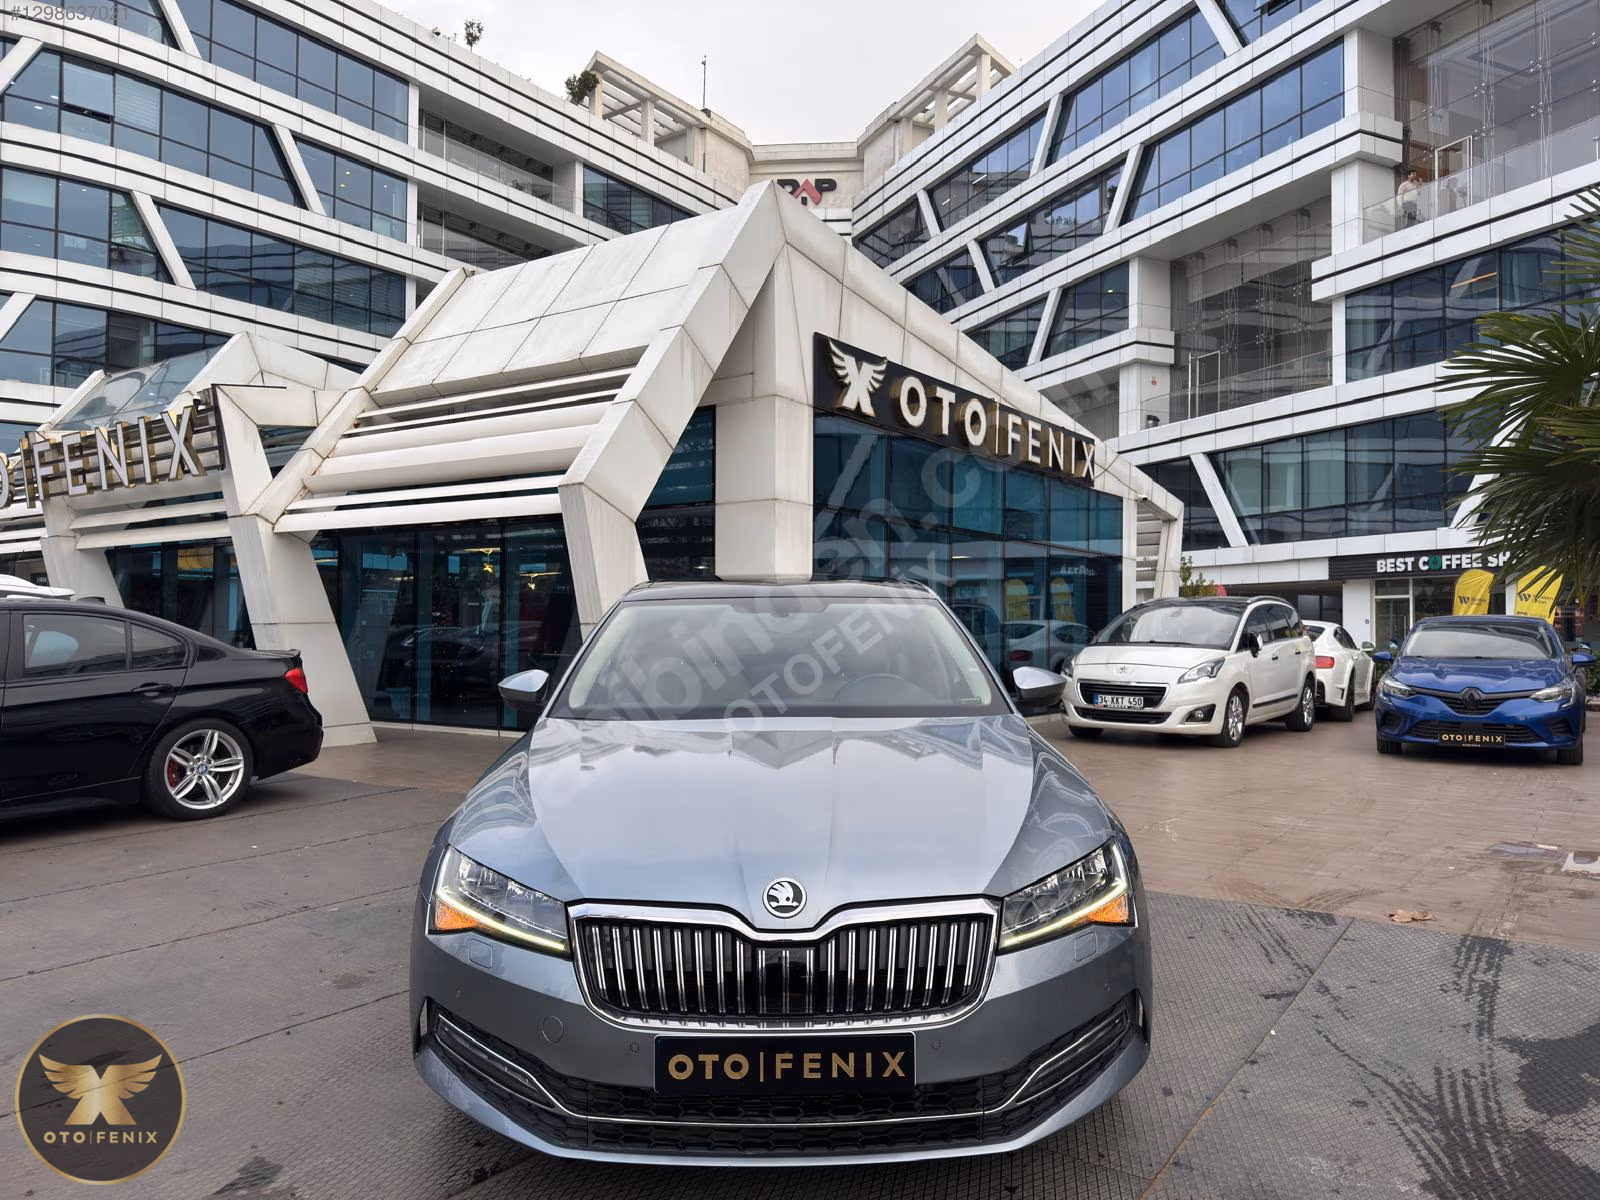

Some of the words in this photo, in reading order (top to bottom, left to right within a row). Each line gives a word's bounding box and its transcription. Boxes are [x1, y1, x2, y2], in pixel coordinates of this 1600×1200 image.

[1377, 558, 1414, 573] BEST
[1419, 556, 1482, 571] COFFEE
[1099, 695, 1107, 704] 34
[1110, 696, 1124, 705] KKT
[1128, 697, 1143, 707] 450
